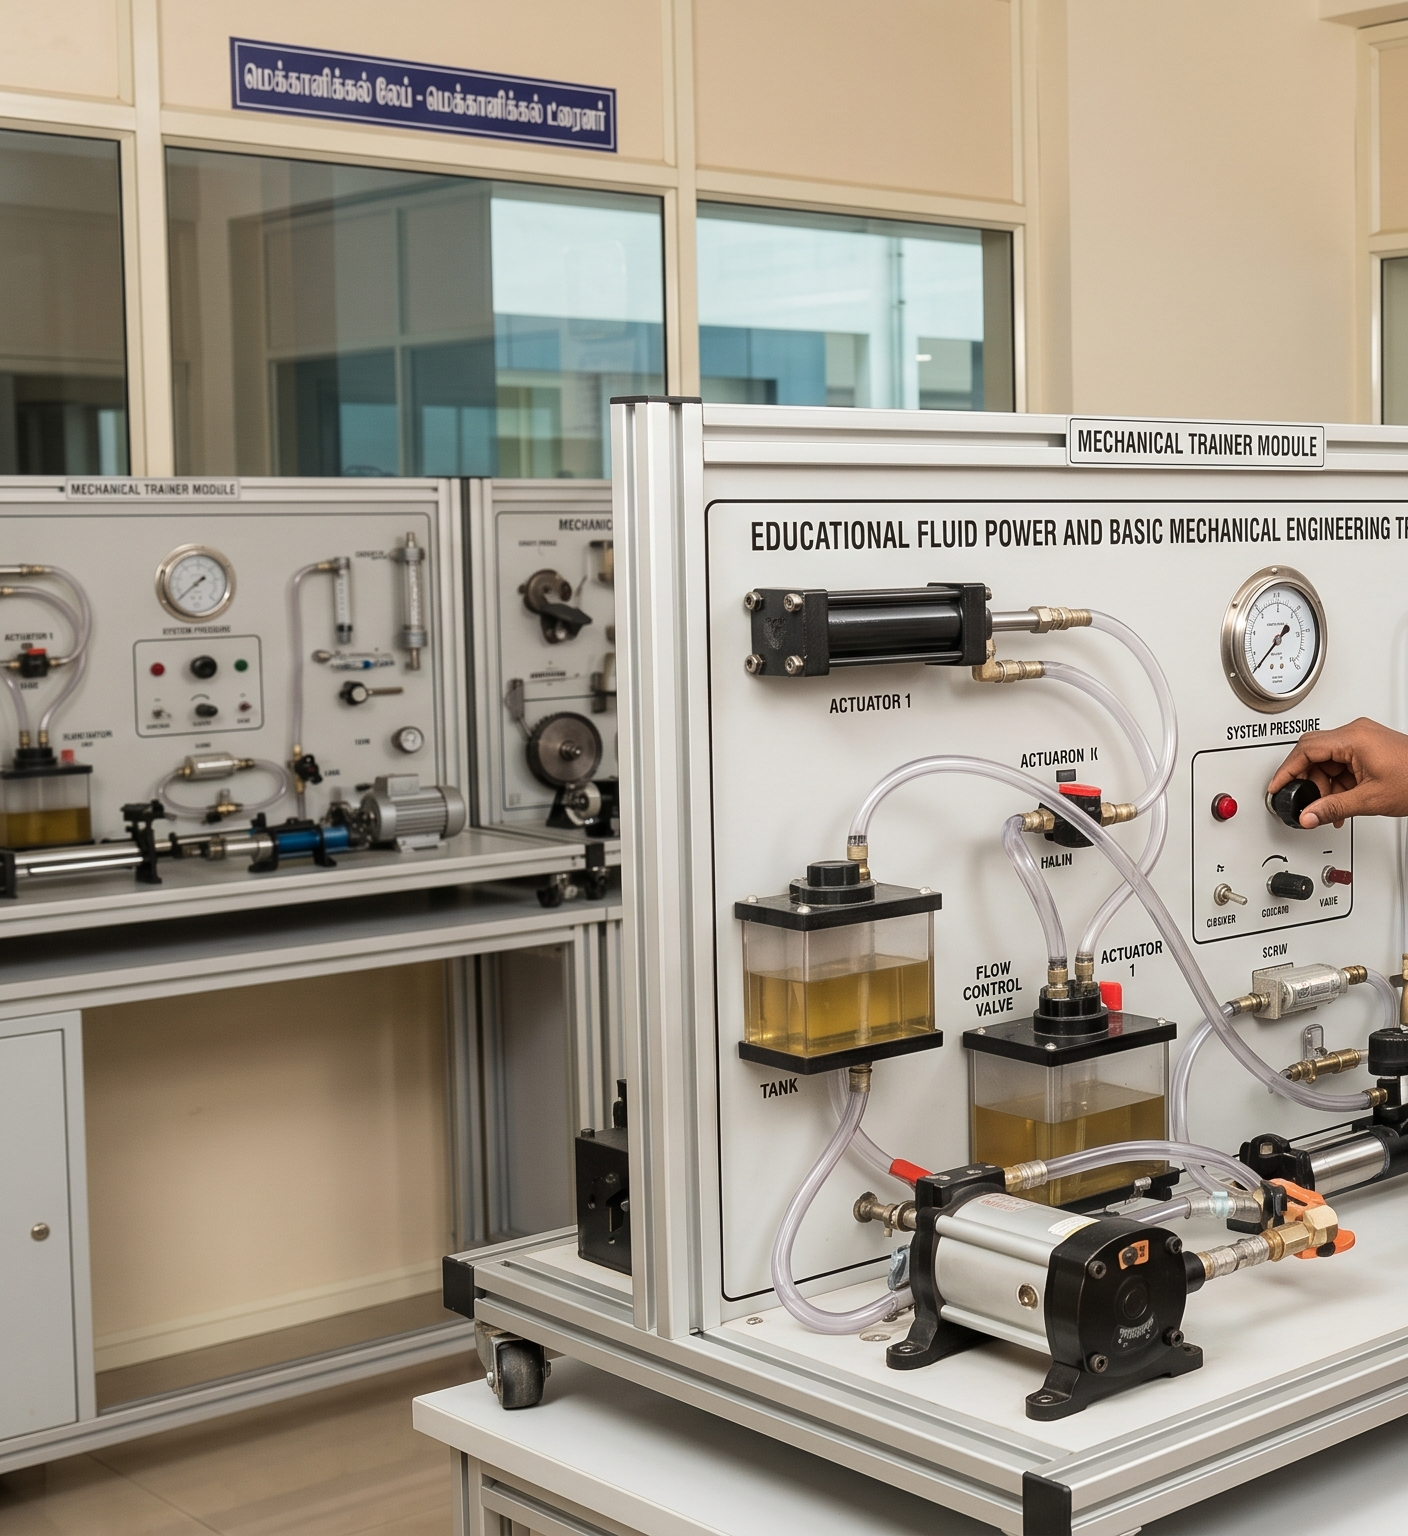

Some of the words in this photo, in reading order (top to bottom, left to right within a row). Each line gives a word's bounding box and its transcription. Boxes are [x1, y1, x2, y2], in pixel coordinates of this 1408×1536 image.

[244, 60, 372, 104] மெக்கானிக்கல்
[376, 76, 413, 108] லேப்
[426, 83, 543, 124] மெக்கானிக்கல்
[1078, 430, 1184, 454] MECHANICAL
[1188, 432, 1253, 456] TRAINER
[1258, 435, 1317, 457] MODULE
[751, 521, 909, 551] EDUCATIONAL
[918, 520, 977, 548] FLUID
[986, 519, 1057, 547] POWER
[1063, 519, 1102, 546] AND
[1110, 518, 1163, 544] BASIC
[1170, 517, 1281, 544] MECHANICAL
[1287, 516, 1390, 541] ENGINEERING
[830, 694, 901, 713] ACTUATOR
[905, 693, 910, 708] 1
[1227, 723, 1266, 740] SYSTEM
[1270, 718, 1320, 736] PRESSURE
[1020, 748, 1084, 768] ACTUARON
[1101, 940, 1163, 964] ACTUATOR
[1262, 943, 1288, 958] SCRW
[976, 961, 1011, 980] FLOW
[1130, 964, 1135, 977] 1
[963, 978, 1022, 1001] CONTROL
[976, 997, 1013, 1017] VALVE
[760, 1078, 798, 1099] TANK
